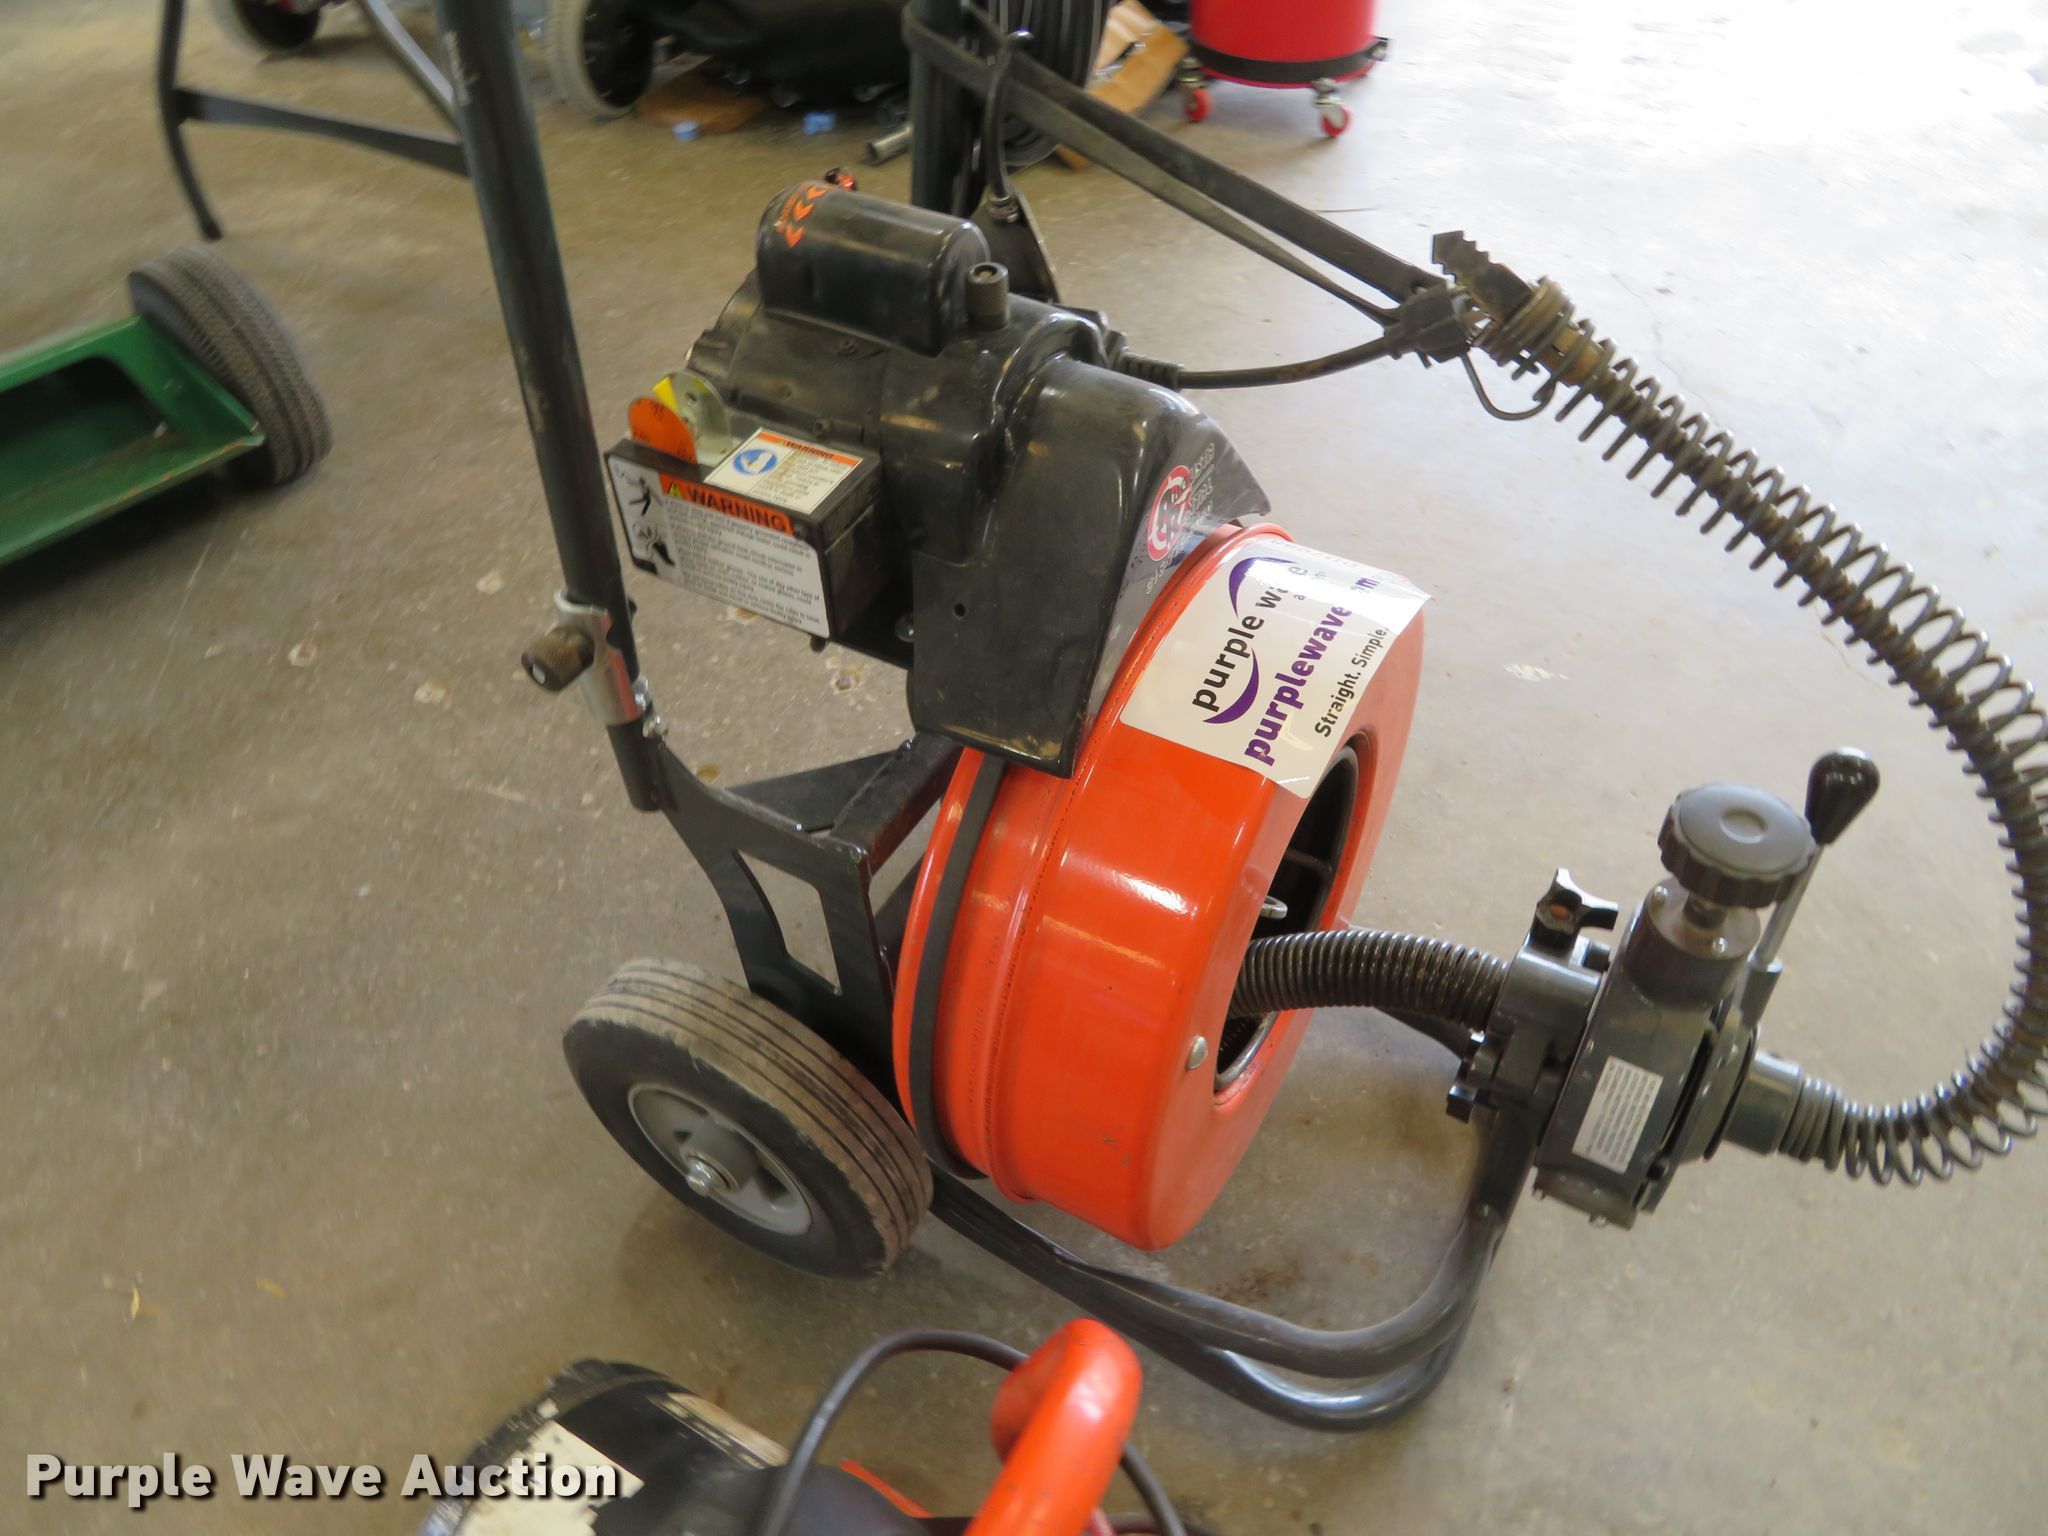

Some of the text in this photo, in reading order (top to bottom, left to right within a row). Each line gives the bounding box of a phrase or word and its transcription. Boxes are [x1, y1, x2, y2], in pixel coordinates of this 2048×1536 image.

[787, 441, 834, 460] WARNING
[690, 488, 787, 531] WARNING
[1192, 565, 1309, 713] purple we
[1244, 576, 1381, 767] purplewavem
[1314, 671, 1361, 739] Straight.
